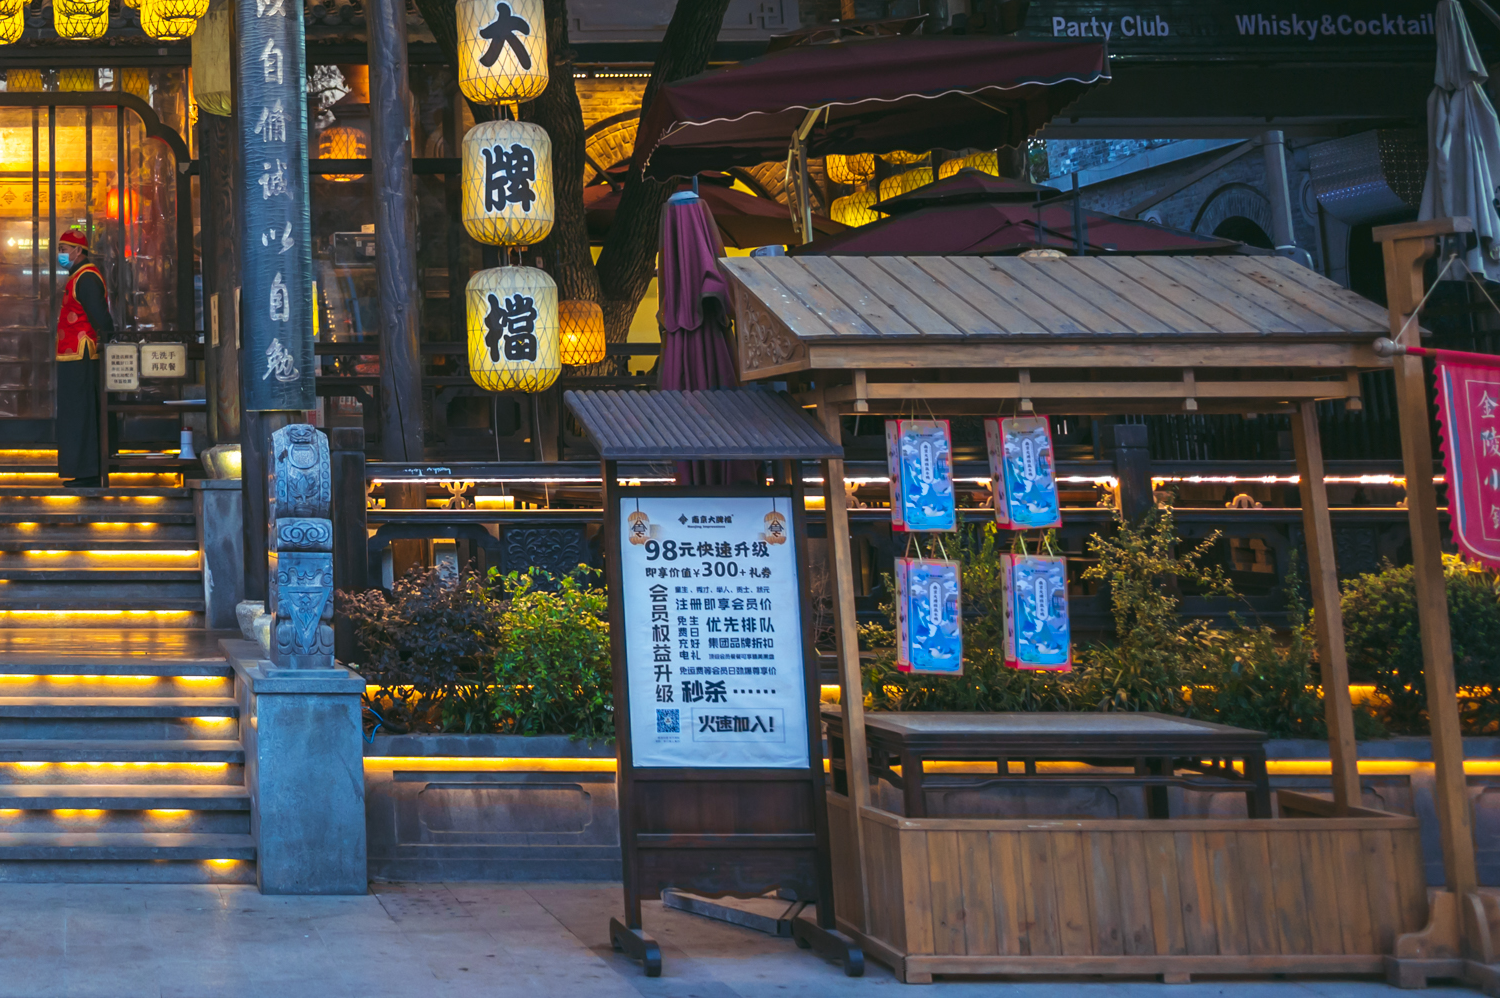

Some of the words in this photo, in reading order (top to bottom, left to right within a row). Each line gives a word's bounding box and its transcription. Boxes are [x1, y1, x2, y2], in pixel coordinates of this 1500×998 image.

[1051, 16, 1113, 41] Party
[1119, 15, 1170, 37] Club
[1235, 14, 1435, 41] Whisky&Cocktail
[151, 351, 176, 360] 先洗手
[151, 362, 176, 371] 再取餐
[644, 539, 771, 561] 98元快速升级
[675, 597, 772, 611] 注册即享会员价
[705, 616, 776, 633] 优先排队
[649, 583, 675, 704] 会员权益升级
[708, 637, 774, 649] 集团品牌折扣
[698, 715, 775, 733] 火速加入！
